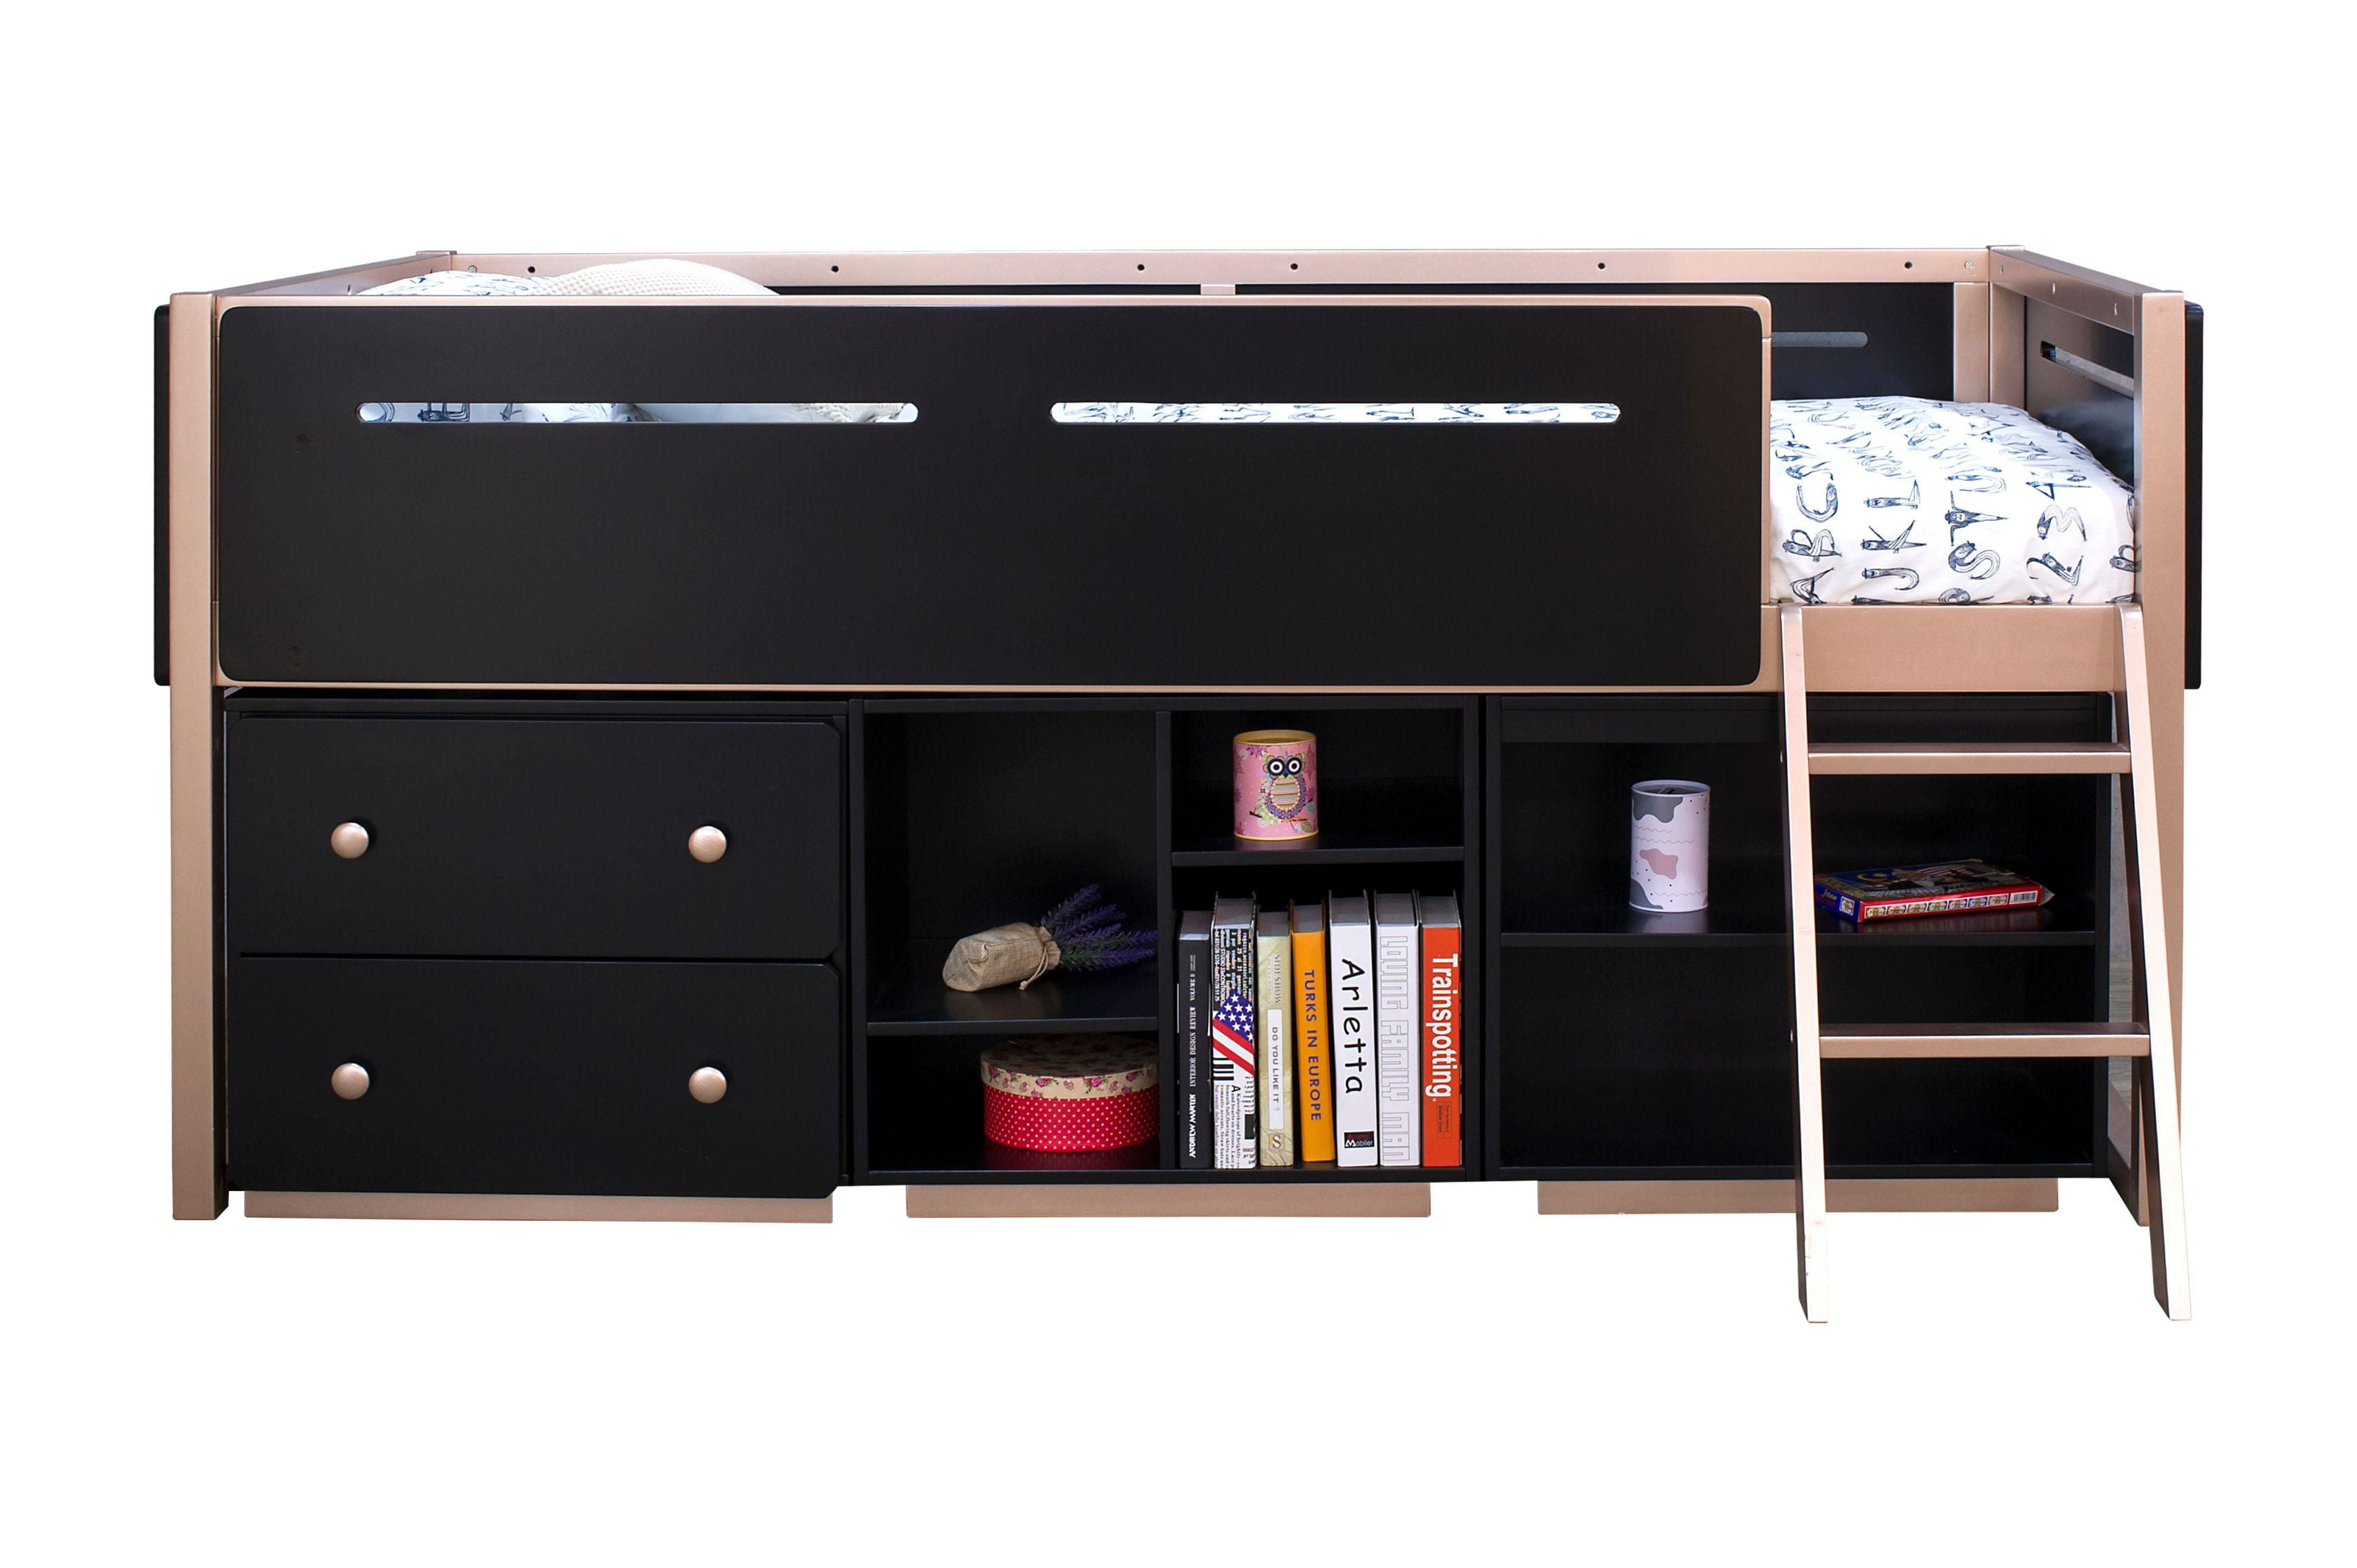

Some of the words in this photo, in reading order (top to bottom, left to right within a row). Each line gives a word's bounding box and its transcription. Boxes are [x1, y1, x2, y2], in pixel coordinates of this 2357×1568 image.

[1304, 969, 1316, 1022] TURKS
[1272, 1027, 1278, 1041] DO
[1307, 1029, 1318, 1049] IN
[1341, 958, 1369, 1095] Arletta
[1424, 953, 1458, 1098] Trainspotting
[1380, 1020, 1410, 1102] FAMILY
[1273, 1094, 1279, 1103] IT
[1308, 1057, 1322, 1121] EUROPE
[1382, 1112, 1412, 1161] MAN
